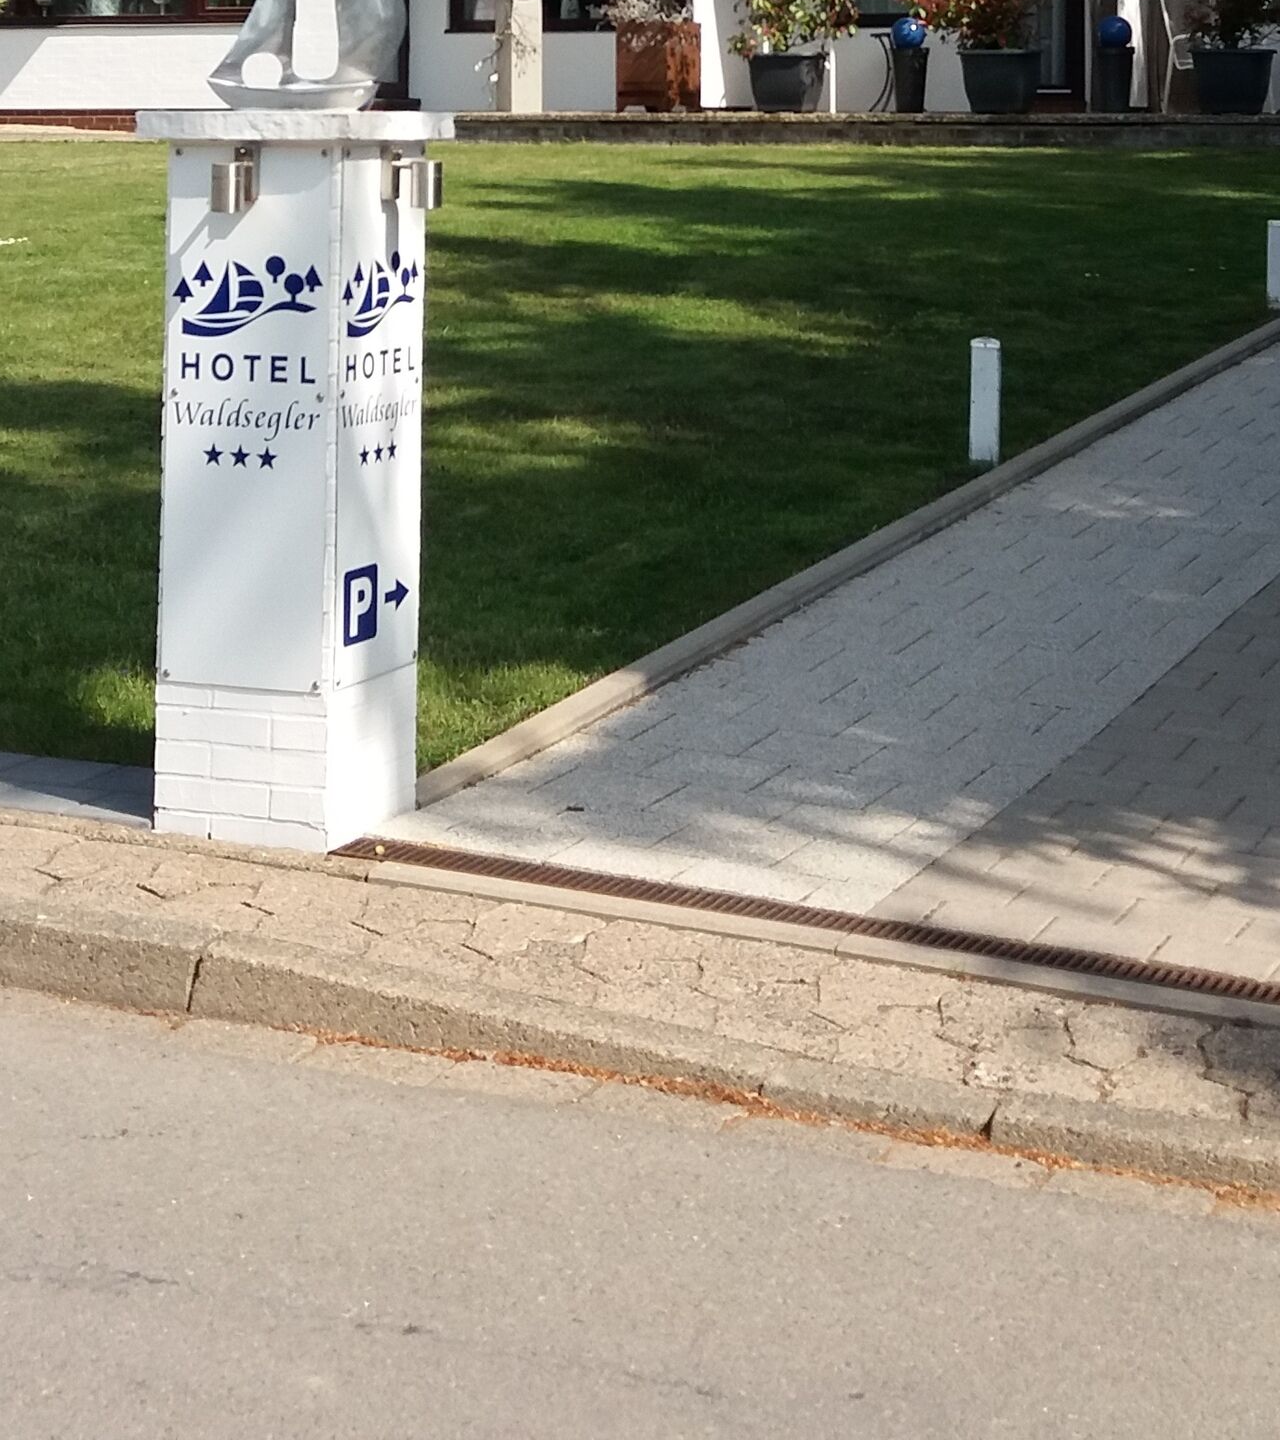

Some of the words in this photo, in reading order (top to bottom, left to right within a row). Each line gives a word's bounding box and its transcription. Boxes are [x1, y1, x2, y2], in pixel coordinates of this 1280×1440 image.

[180, 351, 316, 385] HOTEL
[345, 345, 415, 383] HOTEL
[173, 397, 321, 442] Waldsegler
[341, 391, 418, 433] Waldsegler
[349, 576, 374, 639] P
